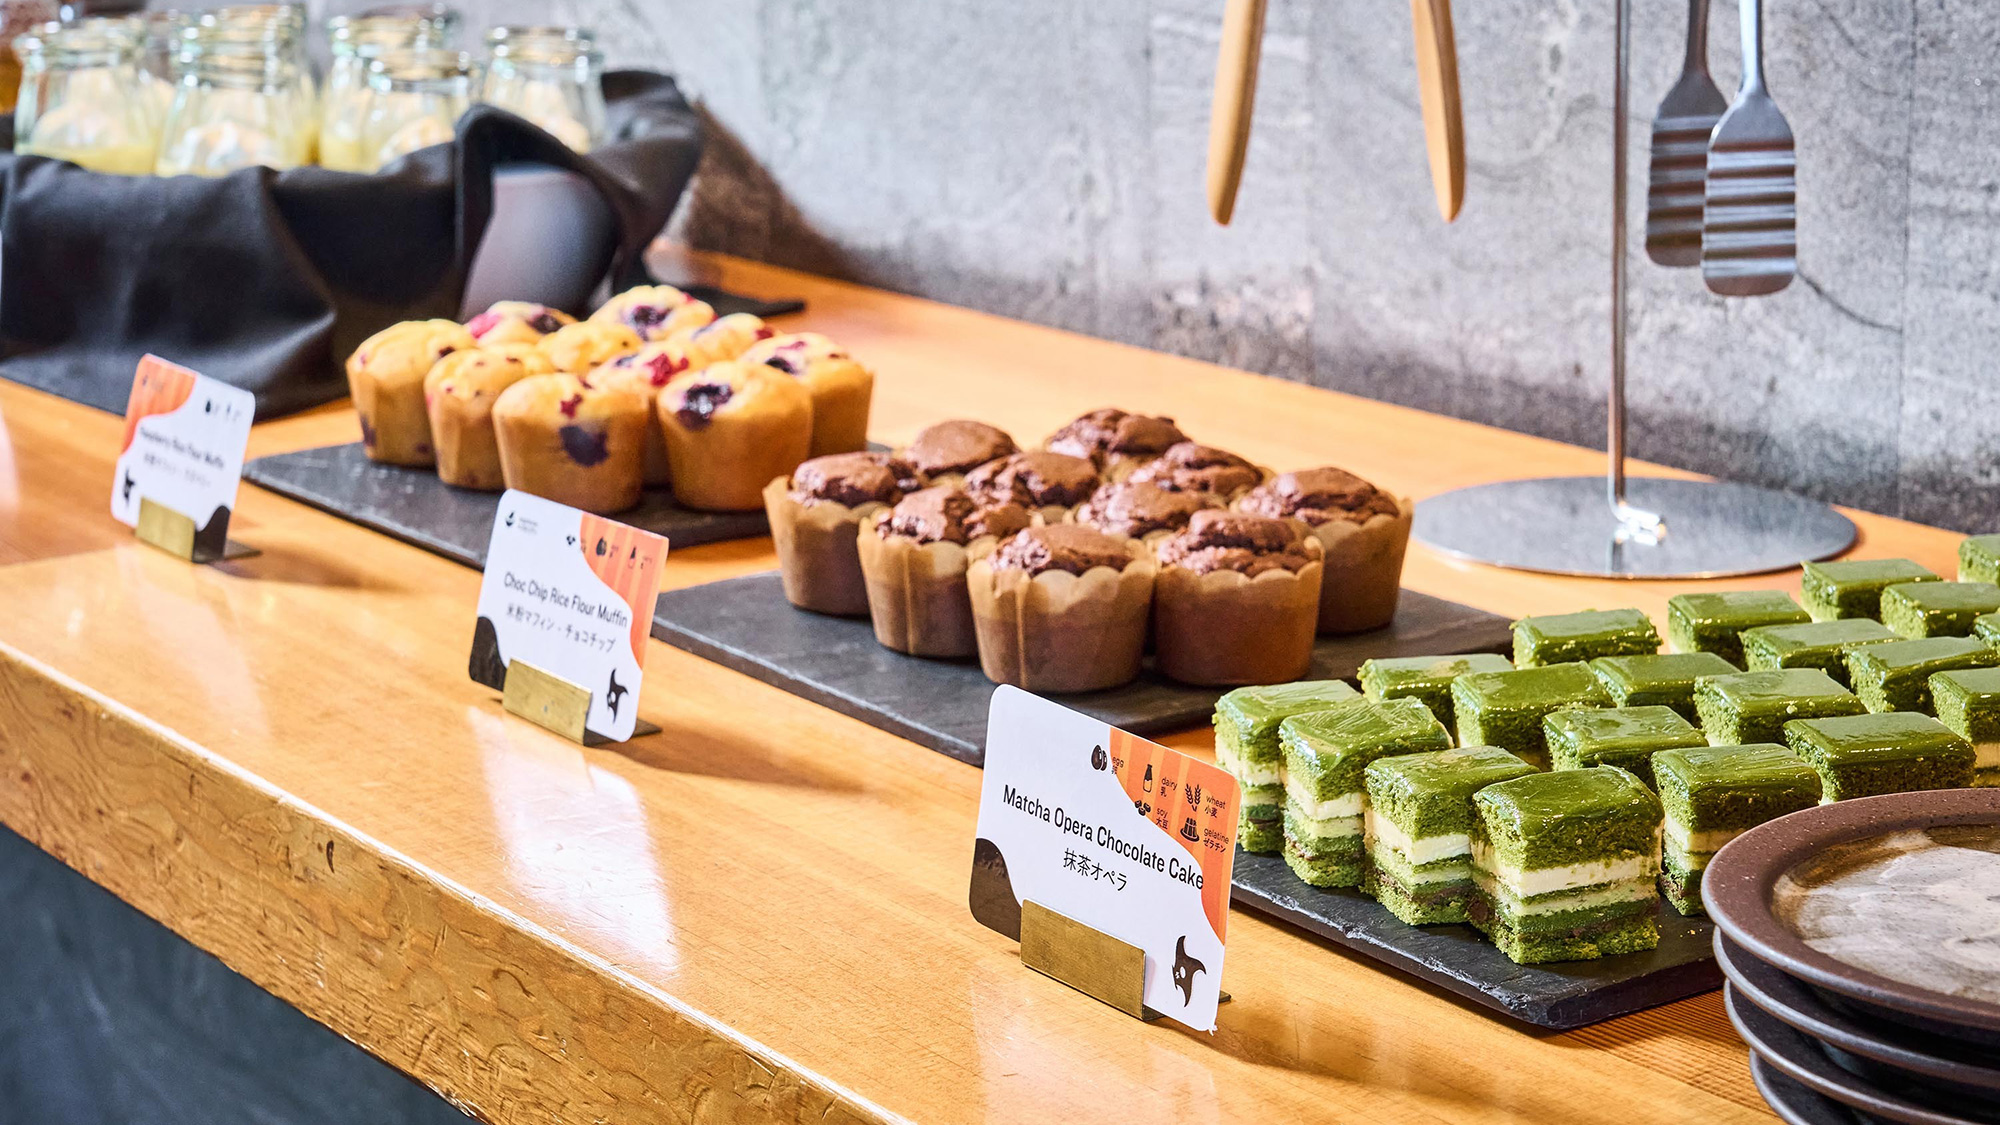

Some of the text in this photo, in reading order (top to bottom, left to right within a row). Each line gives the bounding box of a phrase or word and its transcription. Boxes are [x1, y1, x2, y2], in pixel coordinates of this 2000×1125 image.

[504, 571, 628, 628] Choc Chip Rice Flour Muffin
[1112, 757, 1125, 768] egg
[1161, 777, 1178, 791] dairy
[1206, 795, 1226, 810] wheat
[1157, 808, 1168, 818] soy
[1204, 807, 1218, 819] 小麦
[1155, 817, 1169, 830] 大豆
[1003, 784, 1204, 890] Matcha Opera Chocolate Cake
[1203, 827, 1230, 845] gelatine
[1203, 837, 1227, 854] ゼラチン
[1063, 847, 1128, 892] 抹茶オペラ
